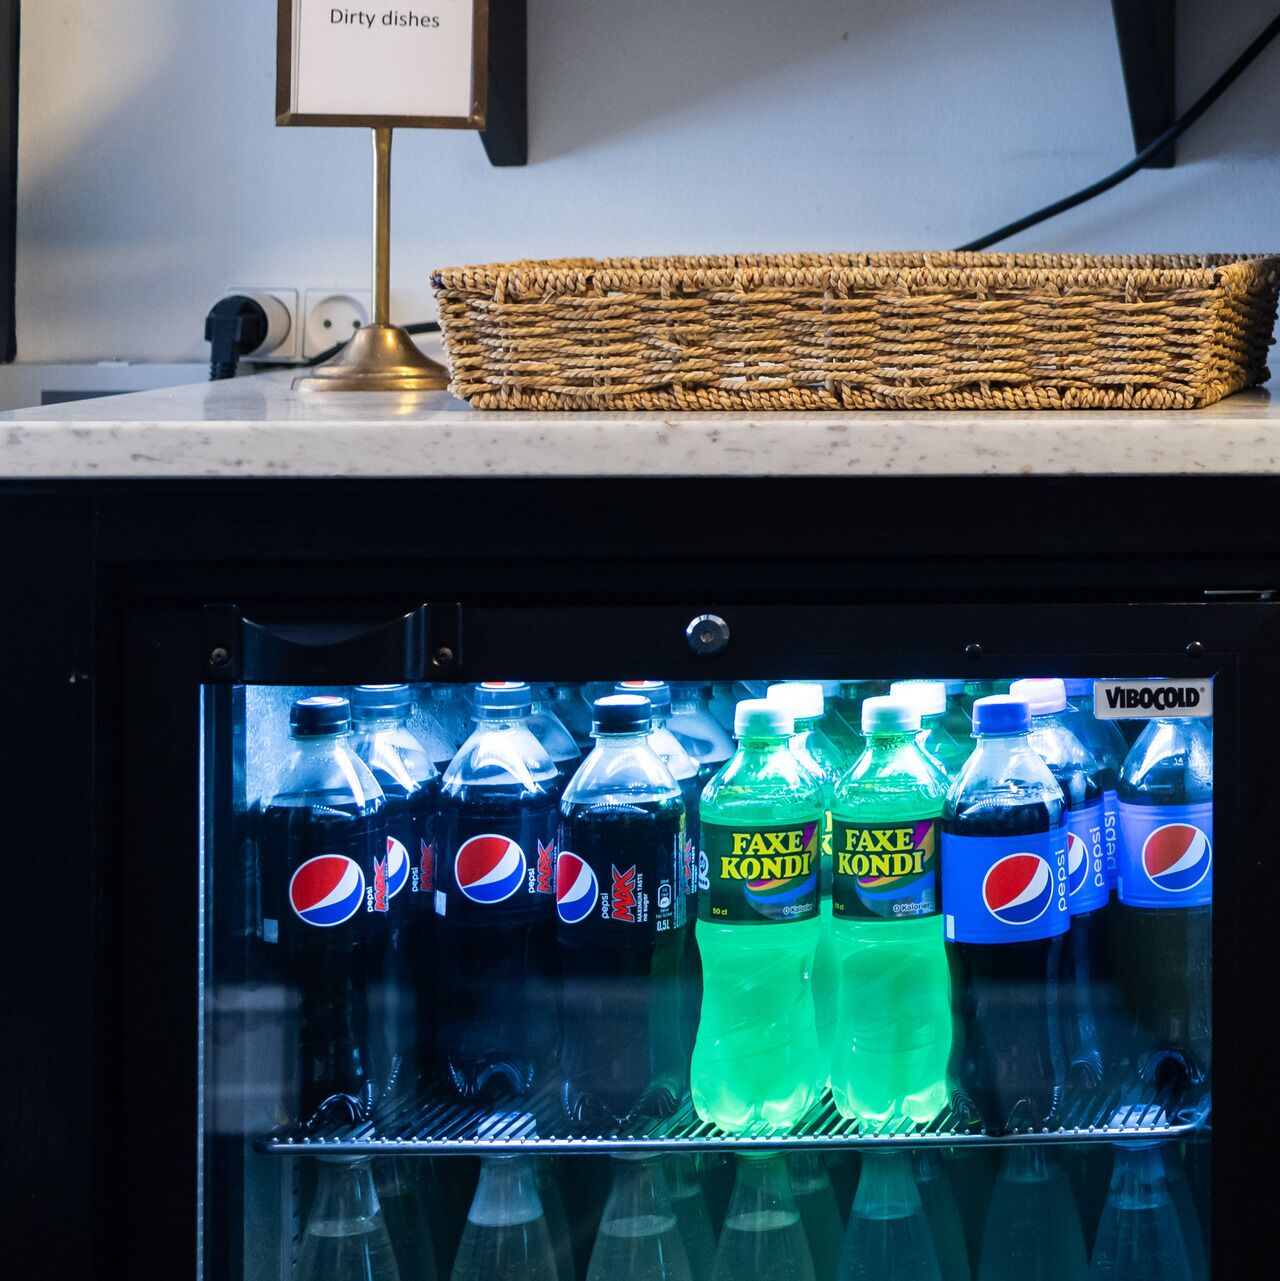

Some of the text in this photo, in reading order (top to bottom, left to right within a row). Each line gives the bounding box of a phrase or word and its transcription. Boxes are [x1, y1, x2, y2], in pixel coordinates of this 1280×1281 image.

[330, 9, 440, 29] Dirty dishes
[1105, 686, 1200, 710] VIBOCOLD
[732, 830, 803, 855] FAXE
[845, 829, 915, 852] FAXE
[537, 838, 554, 894] MAX
[720, 854, 811, 880] KONDI
[837, 851, 923, 876] KONDI
[1090, 826, 1104, 888] pepsi
[411, 867, 419, 892] pepsi
[528, 867, 536, 893] pepsi
[1055, 849, 1067, 912] pepsi
[366, 886, 374, 912] pepsi
[600, 892, 610, 919] pepsi
[611, 863, 636, 923] MAX
[643, 912, 648, 921] no
[712, 908, 728, 916] 50 cl
[901, 902, 931, 912] Kalorier
